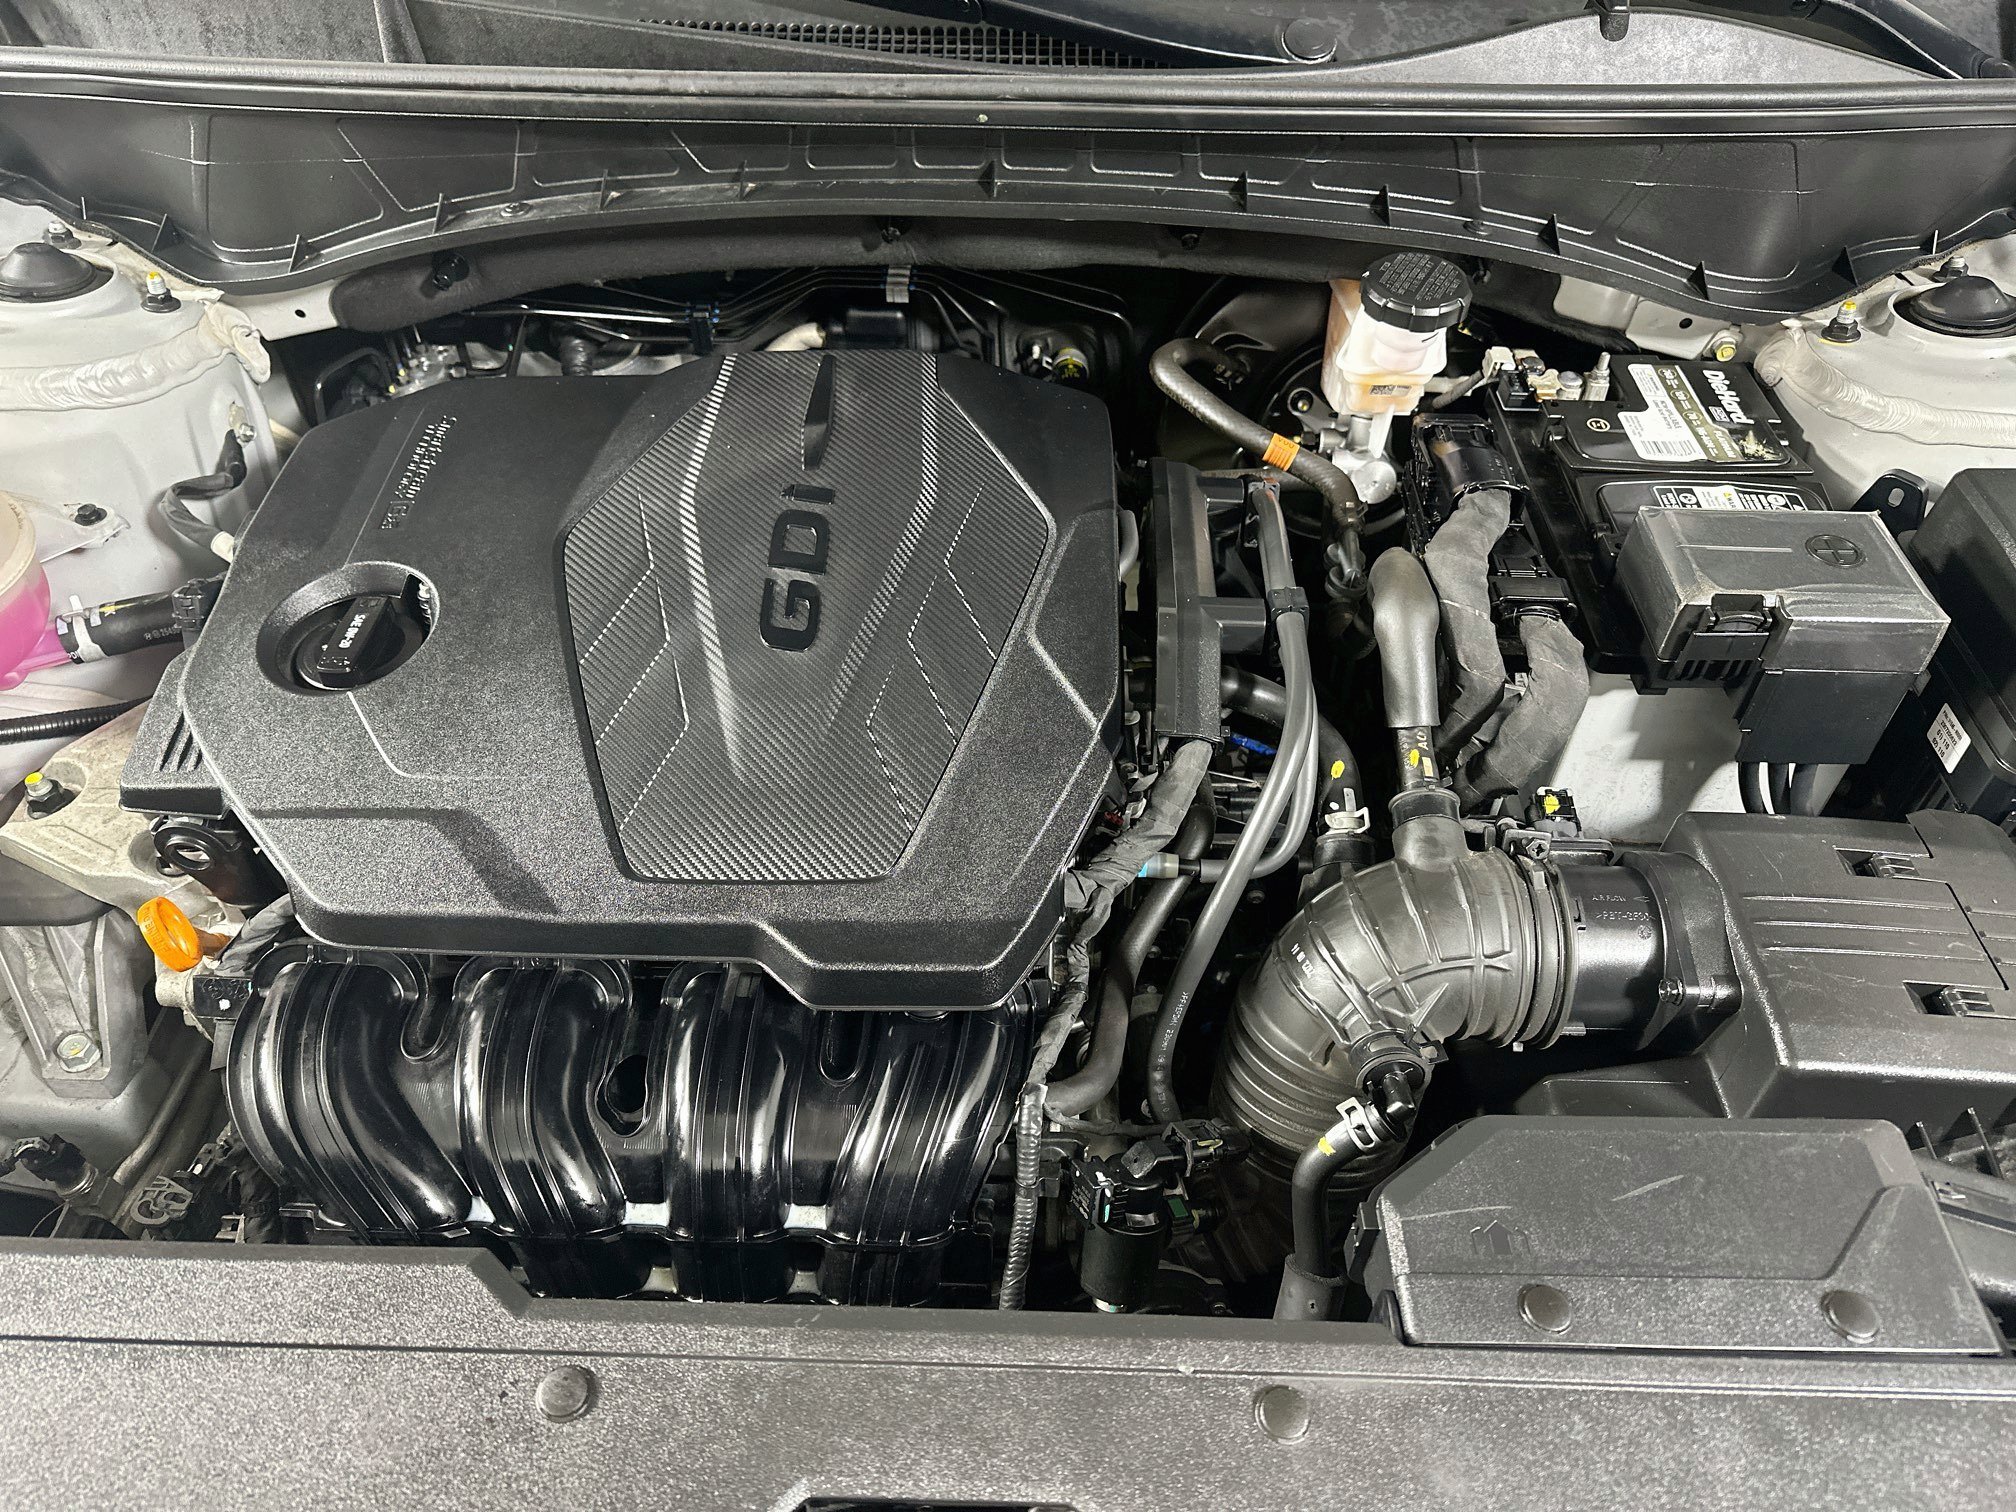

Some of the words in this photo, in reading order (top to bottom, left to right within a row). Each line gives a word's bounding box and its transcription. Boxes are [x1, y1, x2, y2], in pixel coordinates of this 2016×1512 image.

[1702, 369, 1755, 425] DieHard
[350, 614, 366, 628] SAE
[338, 627, 359, 649] 0W-20
